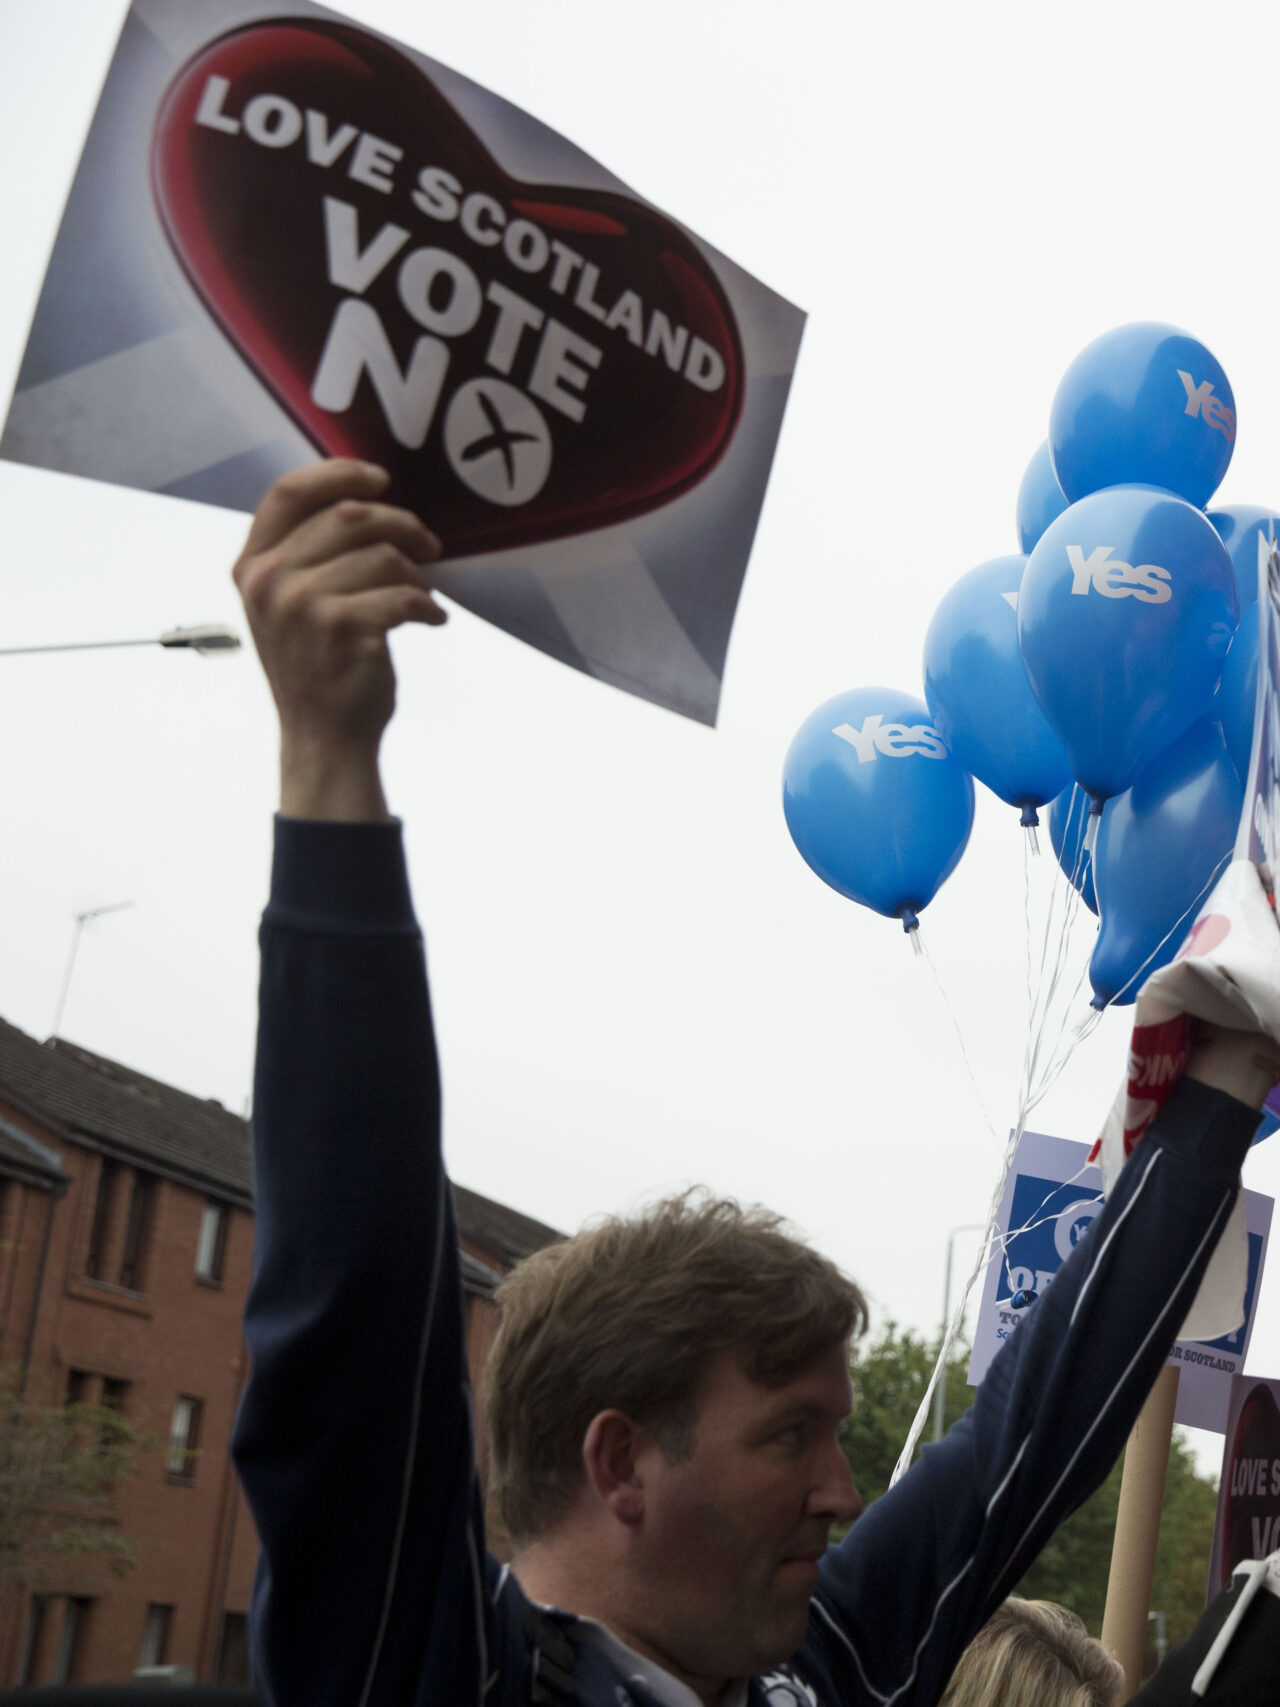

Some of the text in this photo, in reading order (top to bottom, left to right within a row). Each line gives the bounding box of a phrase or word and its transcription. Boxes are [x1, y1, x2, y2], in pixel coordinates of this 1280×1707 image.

[197, 75, 726, 392] LOVE SCOTLAND
[322, 195, 603, 423] VOTE
[311, 297, 553, 507] NO
[1176, 369, 1236, 442] Yes
[1066, 545, 1173, 605] Yes
[832, 714, 947, 764] Yes
[1168, 1346, 1236, 1373] OR SCOTLAND
[1231, 1458, 1268, 1497] LOVE
